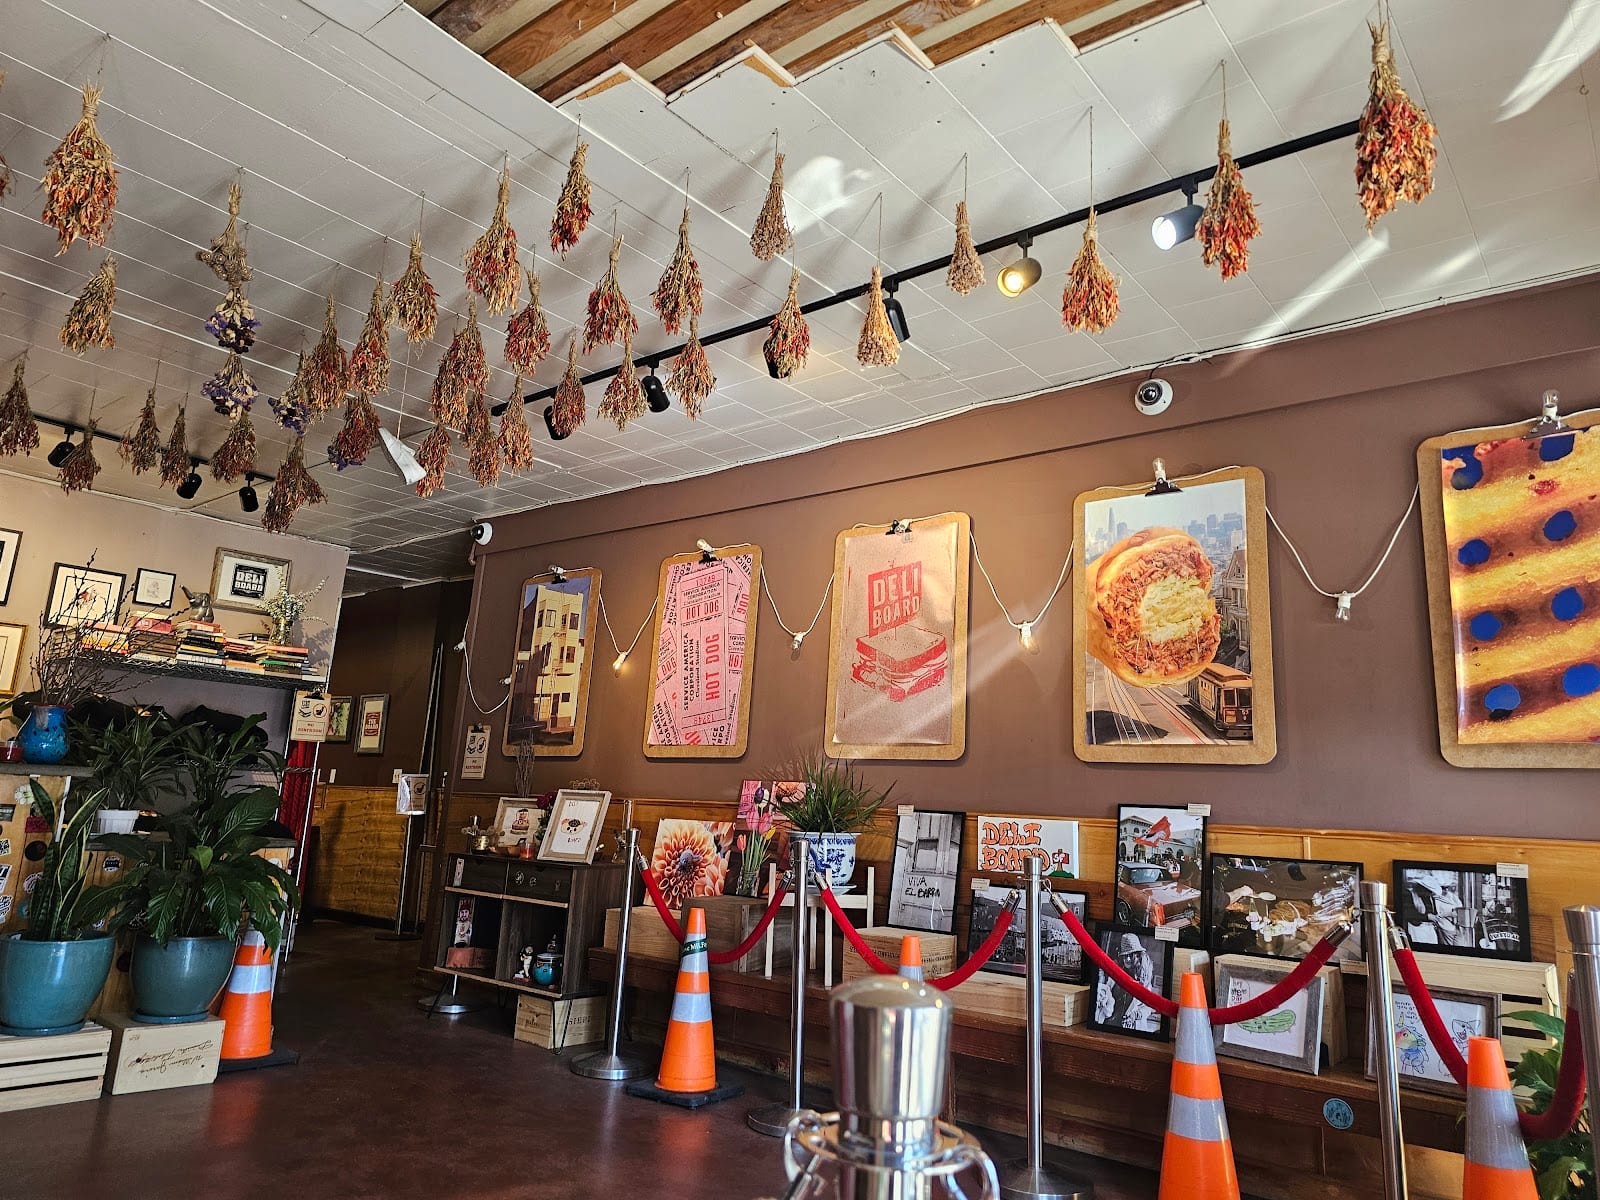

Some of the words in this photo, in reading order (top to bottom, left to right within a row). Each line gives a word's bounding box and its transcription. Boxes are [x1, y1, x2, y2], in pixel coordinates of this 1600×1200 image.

[234, 581, 263, 592] BOARD
[236, 572, 265, 584] DELI
[872, 568, 919, 607] DELI
[686, 606, 700, 620] HOT
[704, 600, 719, 615] DOG
[872, 596, 920, 629] BOARD
[706, 634, 720, 664] DOG
[706, 672, 720, 700] HOT
[982, 821, 1042, 845] DELI
[905, 888, 916, 896] EL
[908, 876, 927, 887] VIVA
